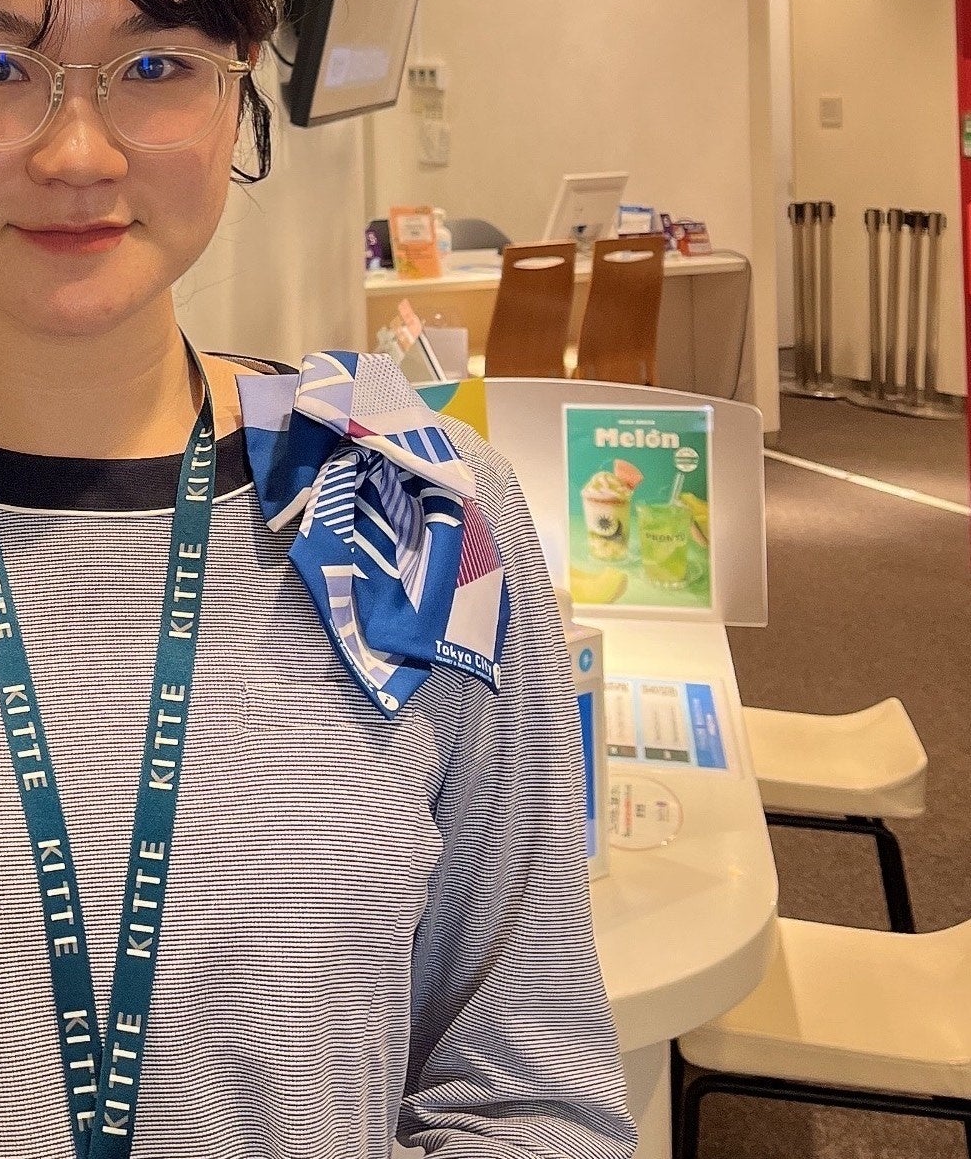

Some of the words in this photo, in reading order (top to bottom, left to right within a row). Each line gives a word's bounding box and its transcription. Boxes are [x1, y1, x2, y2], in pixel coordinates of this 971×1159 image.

[435, 639, 472, 665] Tokyo
[474, 654, 493, 677] City
[2, 683, 48, 792] KITTE
[37, 839, 79, 958] KITTE
[101, 1012, 142, 1136] KITTE
[126, 840, 165, 959] KITTE
[149, 683, 186, 791] KITTE
[168, 542, 202, 639] KITTE
